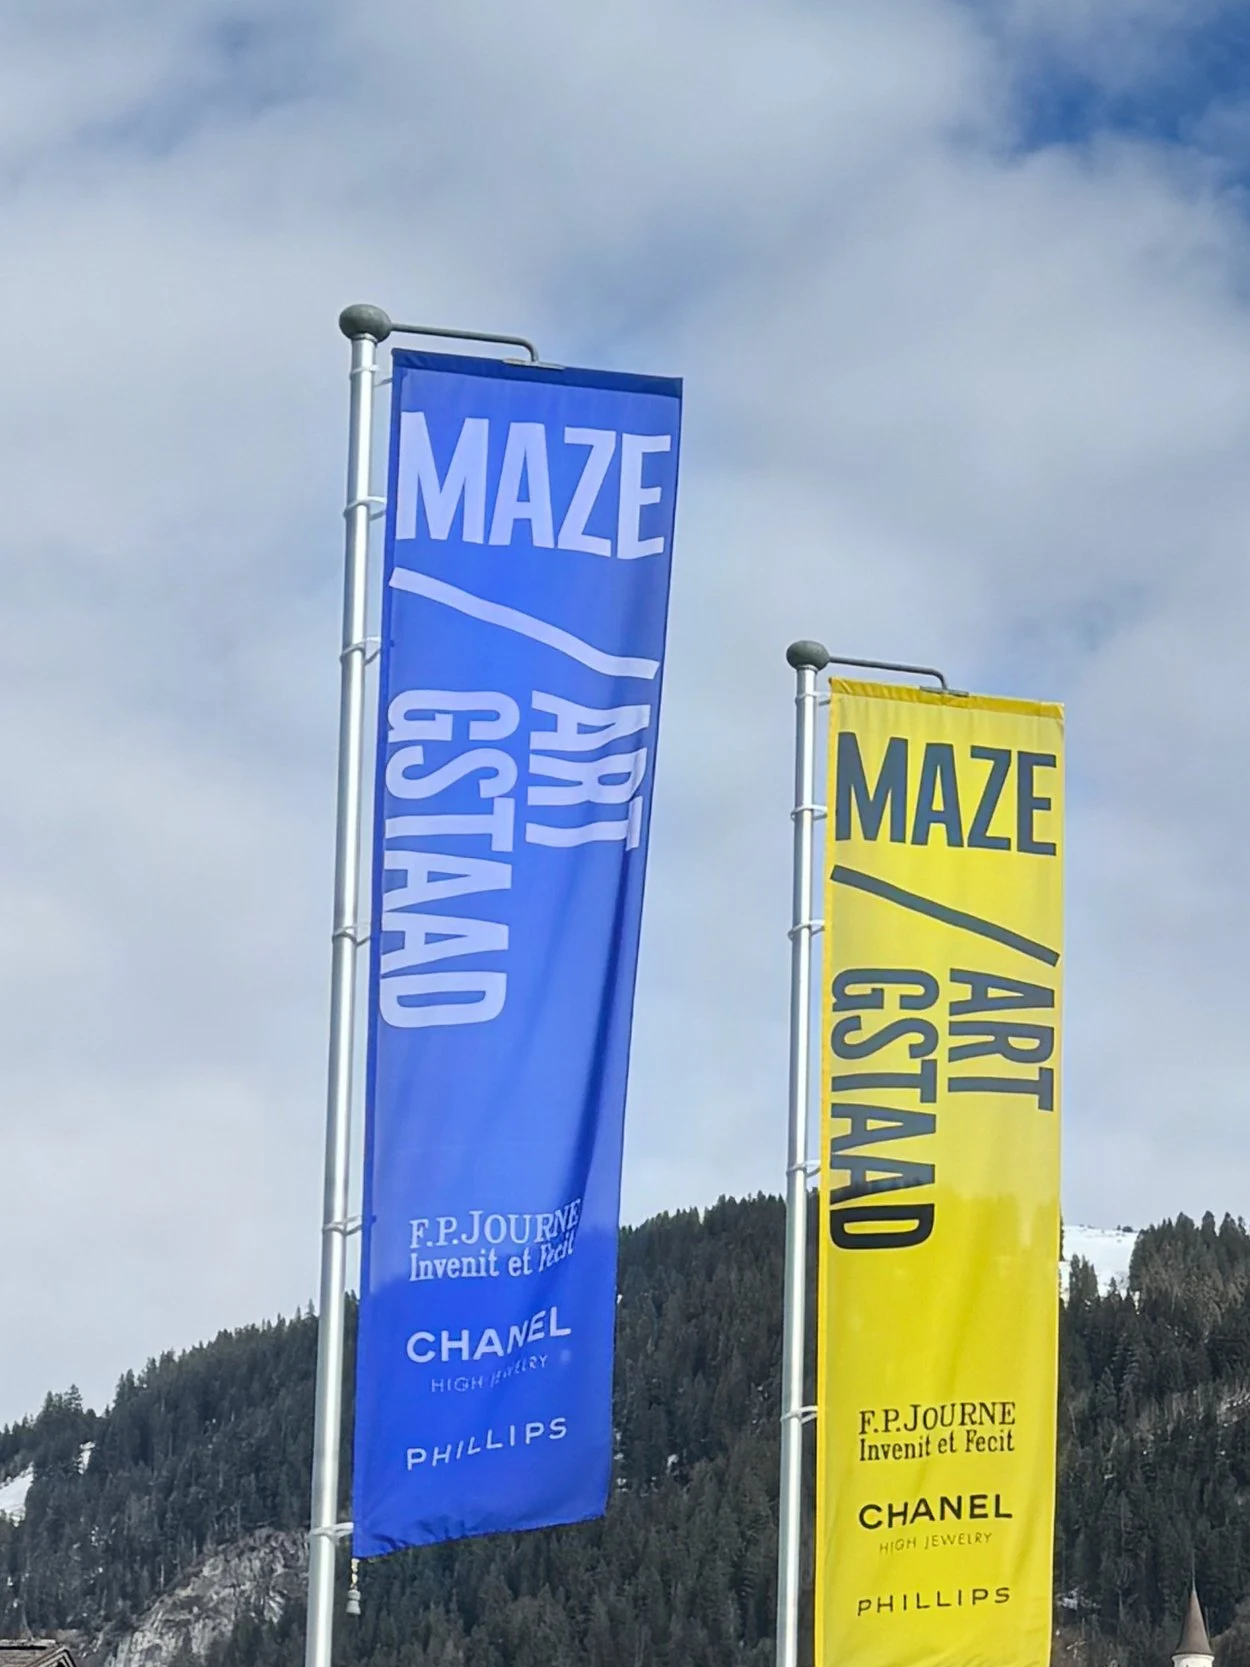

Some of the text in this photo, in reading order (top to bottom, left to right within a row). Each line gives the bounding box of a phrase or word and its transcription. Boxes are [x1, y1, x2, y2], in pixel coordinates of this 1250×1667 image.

[395, 410, 672, 560] MAZE
[525, 689, 651, 850] ART
[834, 730, 1057, 856] MAZE
[379, 688, 520, 1029] GSTAAD
[947, 967, 1055, 1112] ART
[830, 967, 940, 1251] GSTAAD
[409, 1249, 500, 1282] Invenit
[508, 1247, 532, 1276] et
[406, 1305, 572, 1364] CHANEL
[431, 1375, 484, 1393] HIGH
[407, 1417, 567, 1471] PHILLIPS
[859, 1429, 1015, 1463] Invenit et Fecit
[859, 1493, 1013, 1530] CHANEL
[879, 1531, 992, 1555] HIGH JEWELRY
[857, 1586, 1011, 1617] PHILLIPS
